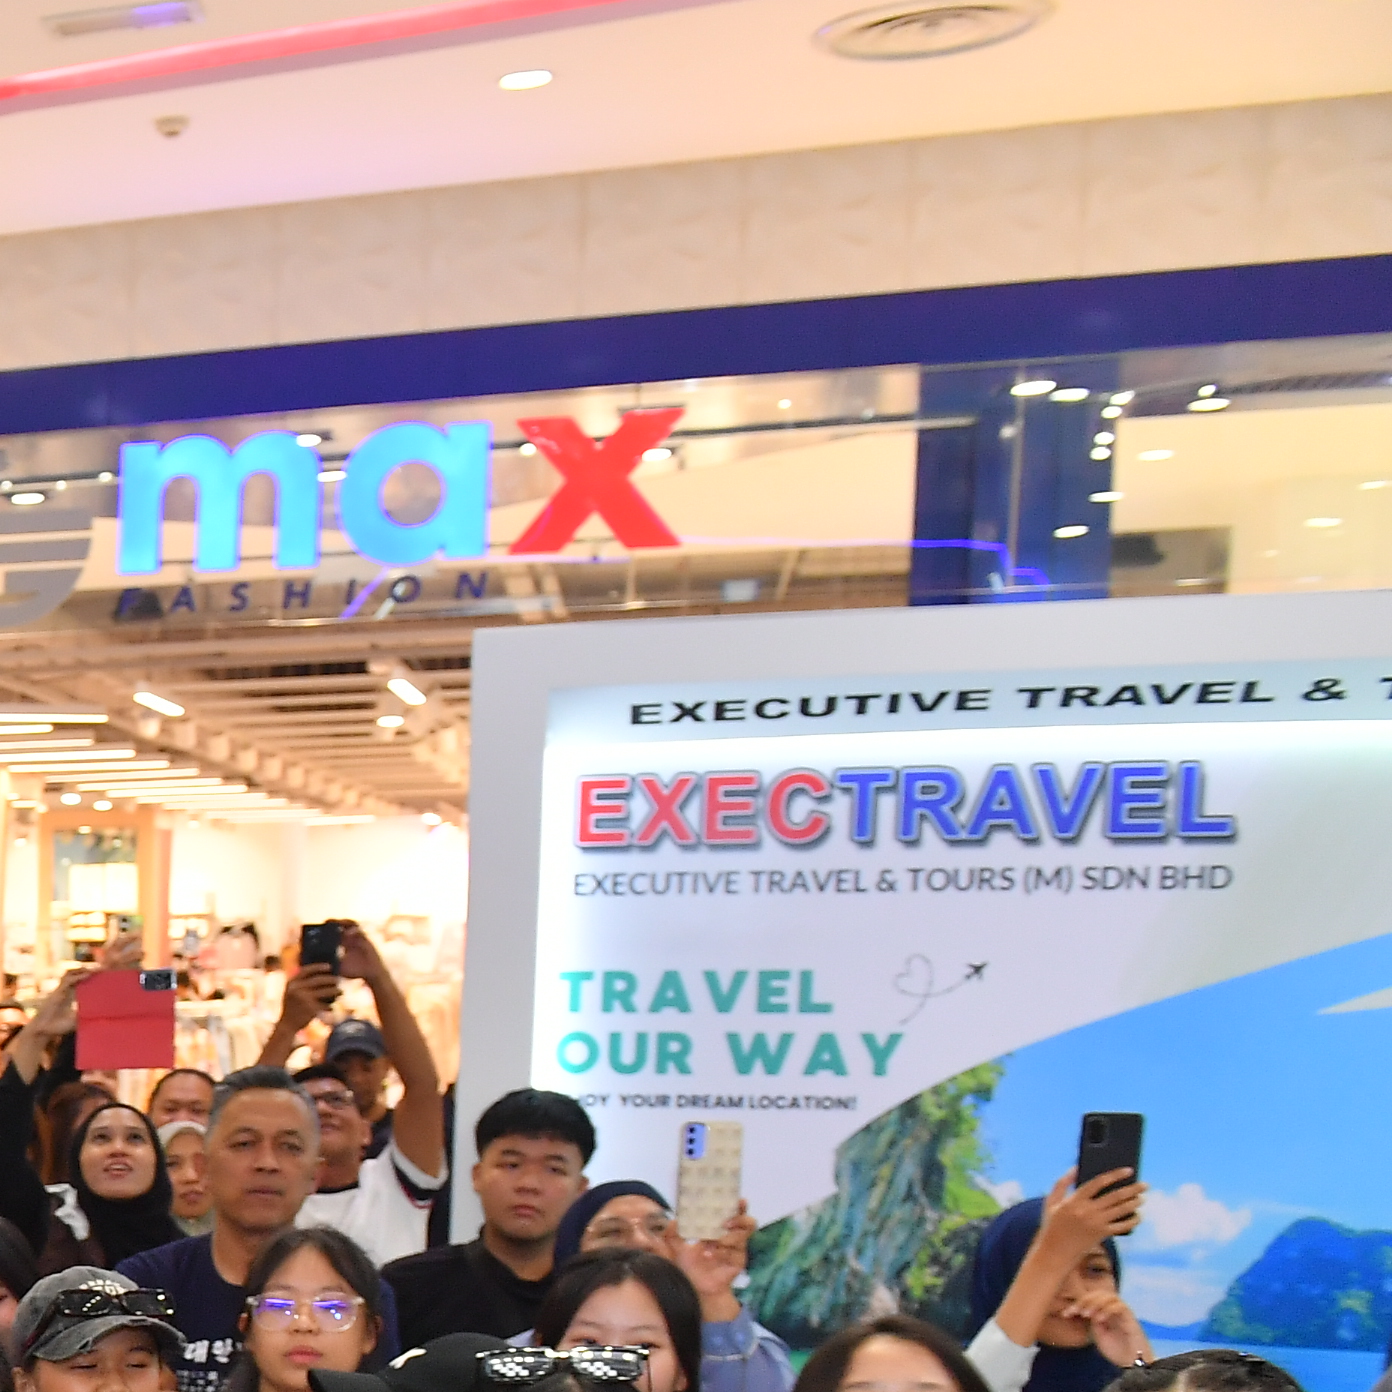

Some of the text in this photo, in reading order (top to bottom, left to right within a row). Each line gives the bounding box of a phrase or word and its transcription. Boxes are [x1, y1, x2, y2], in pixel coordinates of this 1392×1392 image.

[117, 408, 685, 576] max
[117, 571, 489, 615] FASHION
[630, 690, 992, 725] EXECUTIVE
[1017, 680, 1276, 709] TRAVEL
[1302, 677, 1347, 702] &
[574, 760, 1237, 850] EXECTRAVEL
[574, 864, 1234, 896] EXECUTIVE TRAVEL & TOURS (M) SDN BHD
[559, 970, 833, 1013] TRAVEL
[556, 1031, 904, 1077] OUR WAY
[620, 1094, 671, 1108] YOUR
[676, 1094, 744, 1109] DREAM
[748, 1094, 858, 1111] LOCATION!
